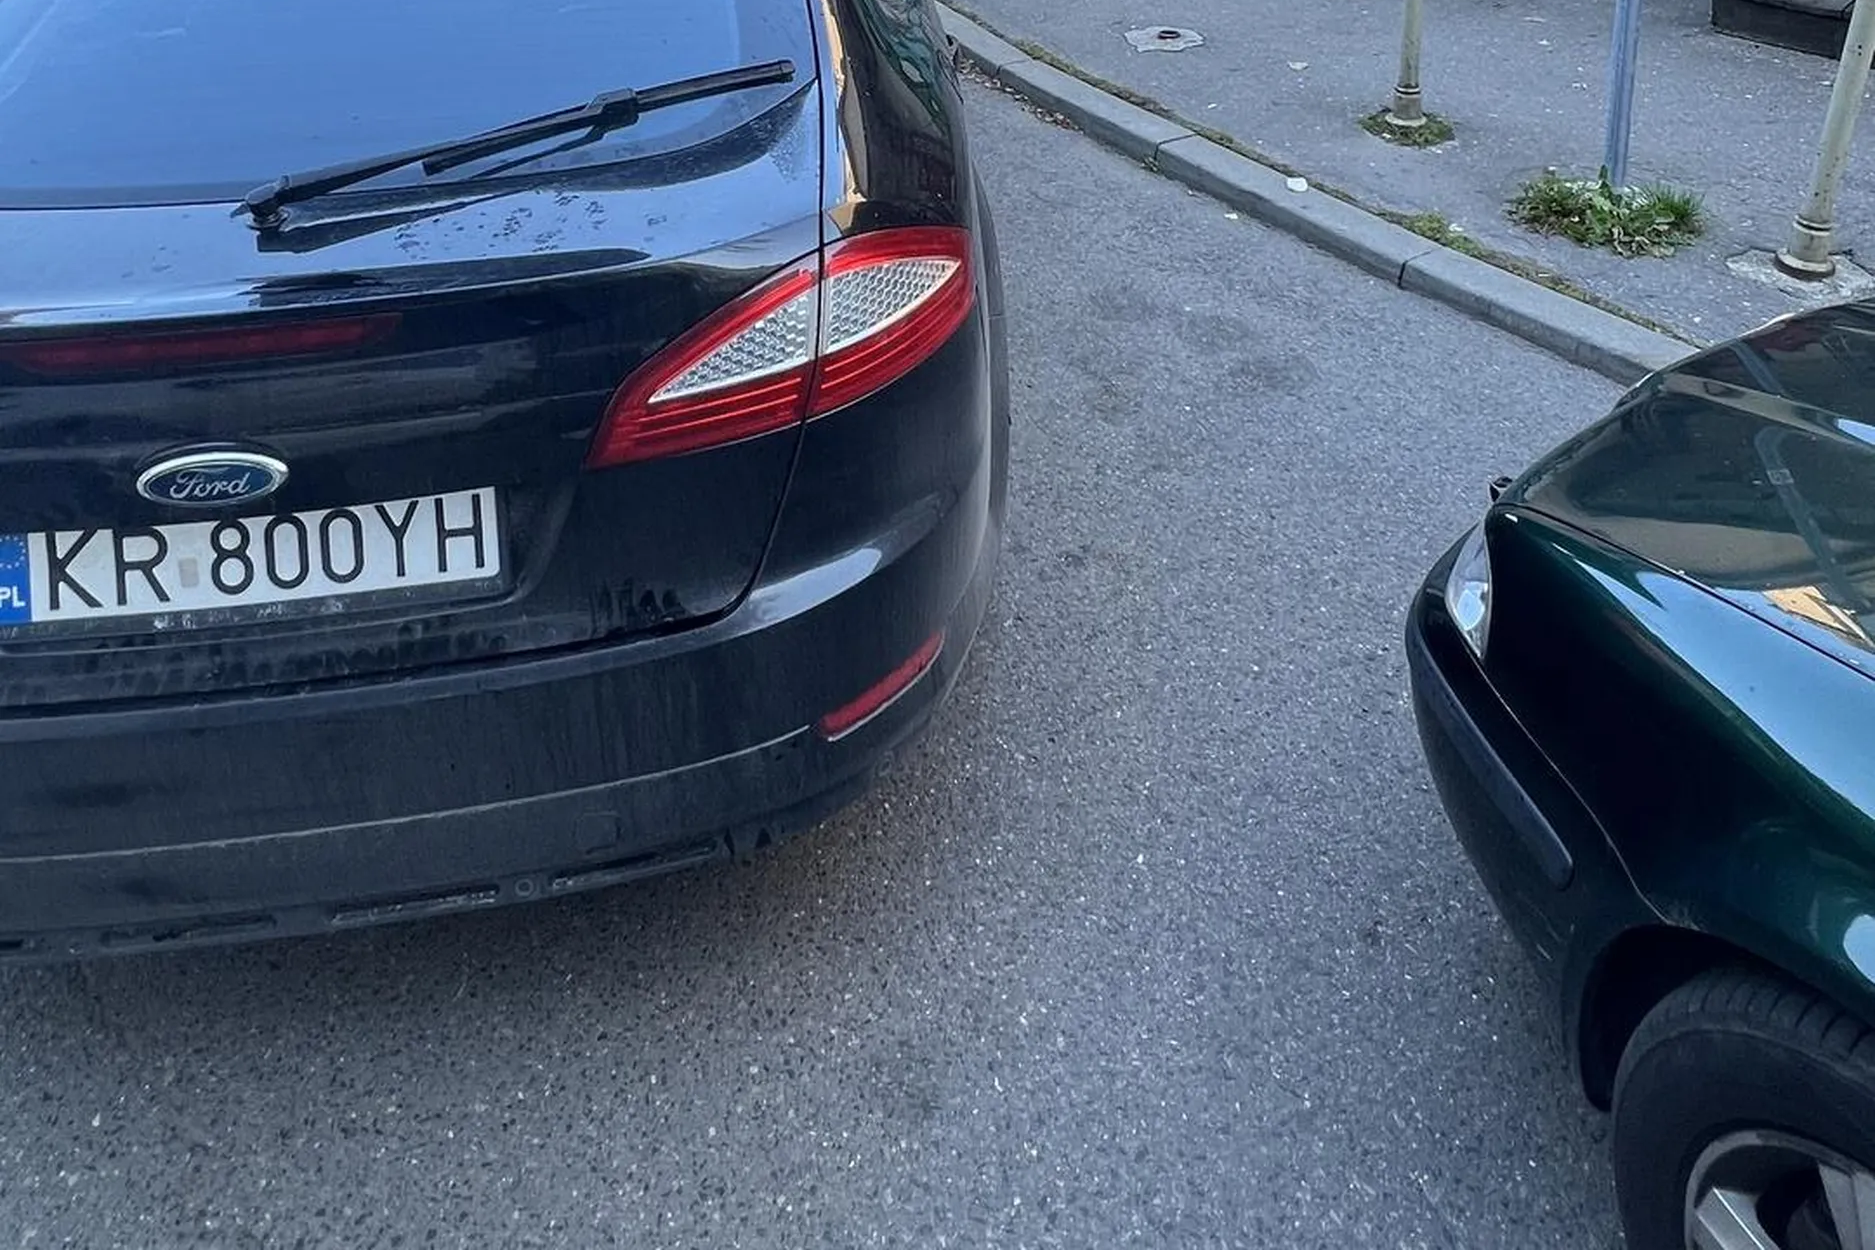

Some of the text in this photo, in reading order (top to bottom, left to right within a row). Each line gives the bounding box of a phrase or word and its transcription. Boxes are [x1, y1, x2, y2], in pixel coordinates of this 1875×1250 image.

[169, 467, 251, 499] Ford
[44, 493, 486, 611] KR 800YH
[0, 585, 26, 608] PL
